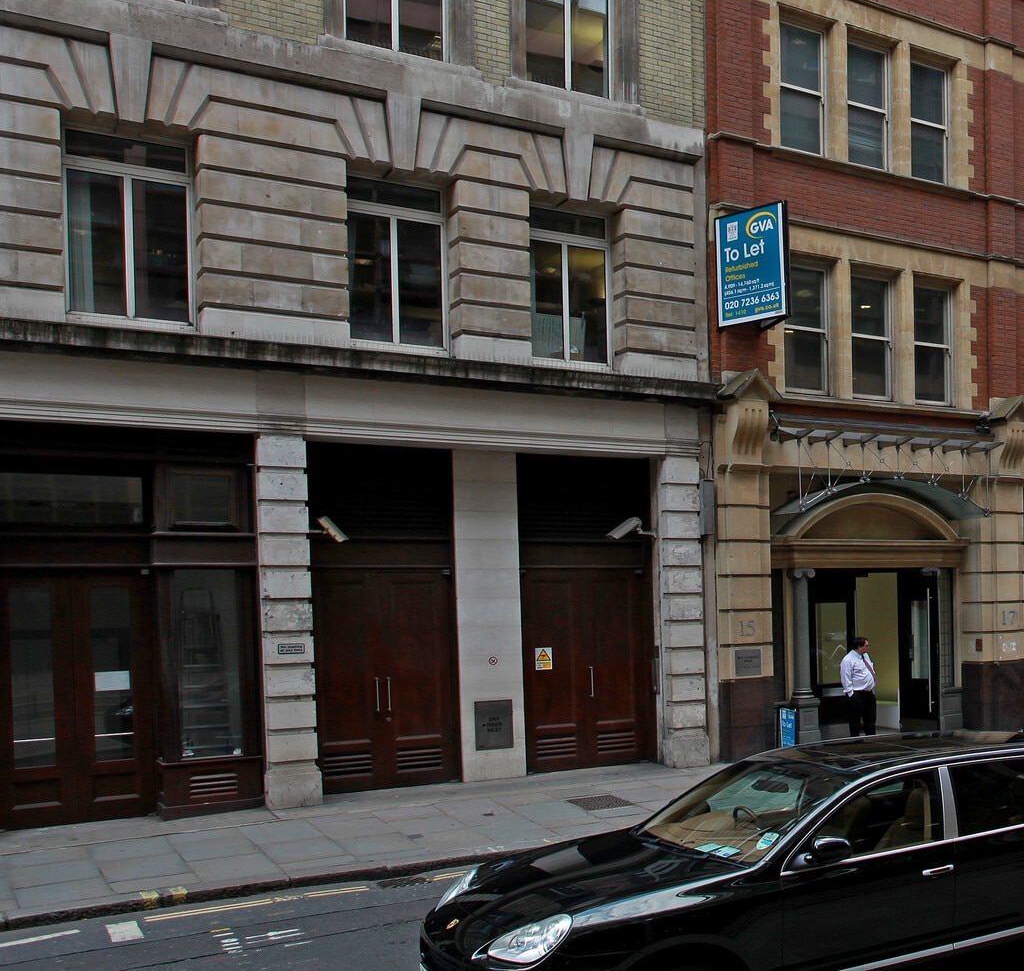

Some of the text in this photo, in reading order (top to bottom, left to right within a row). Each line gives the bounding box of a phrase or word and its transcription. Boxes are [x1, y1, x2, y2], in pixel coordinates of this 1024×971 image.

[750, 219, 774, 234] GVA
[723, 239, 765, 263] To Let
[725, 273, 746, 282] Offices
[724, 291, 780, 310] 020 7236 6363
[1001, 610, 1017, 625] 17
[739, 620, 756, 637] 15
